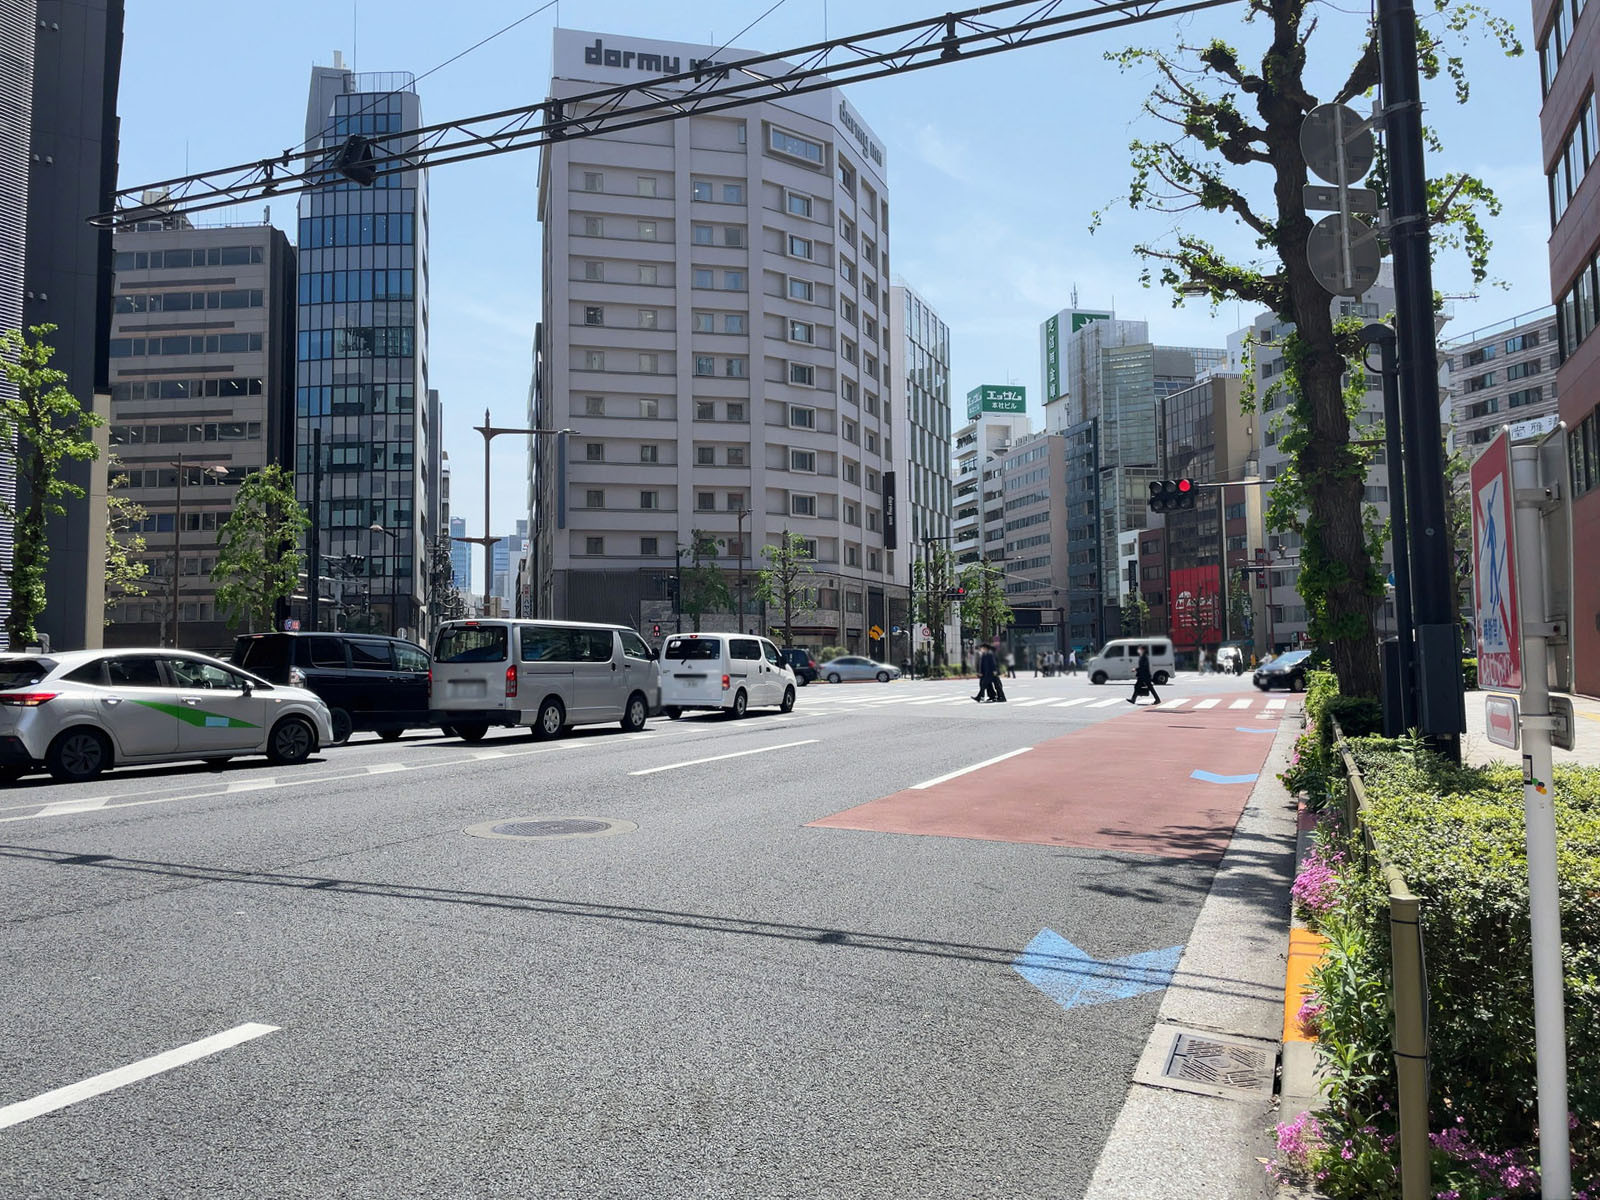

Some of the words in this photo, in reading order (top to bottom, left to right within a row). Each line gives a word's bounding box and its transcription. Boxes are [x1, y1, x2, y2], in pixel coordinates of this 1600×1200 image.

[585, 38, 680, 83] dormy
[839, 99, 869, 159] dormy
[870, 141, 882, 168] inn
[991, 402, 1017, 410] 本社ビル
